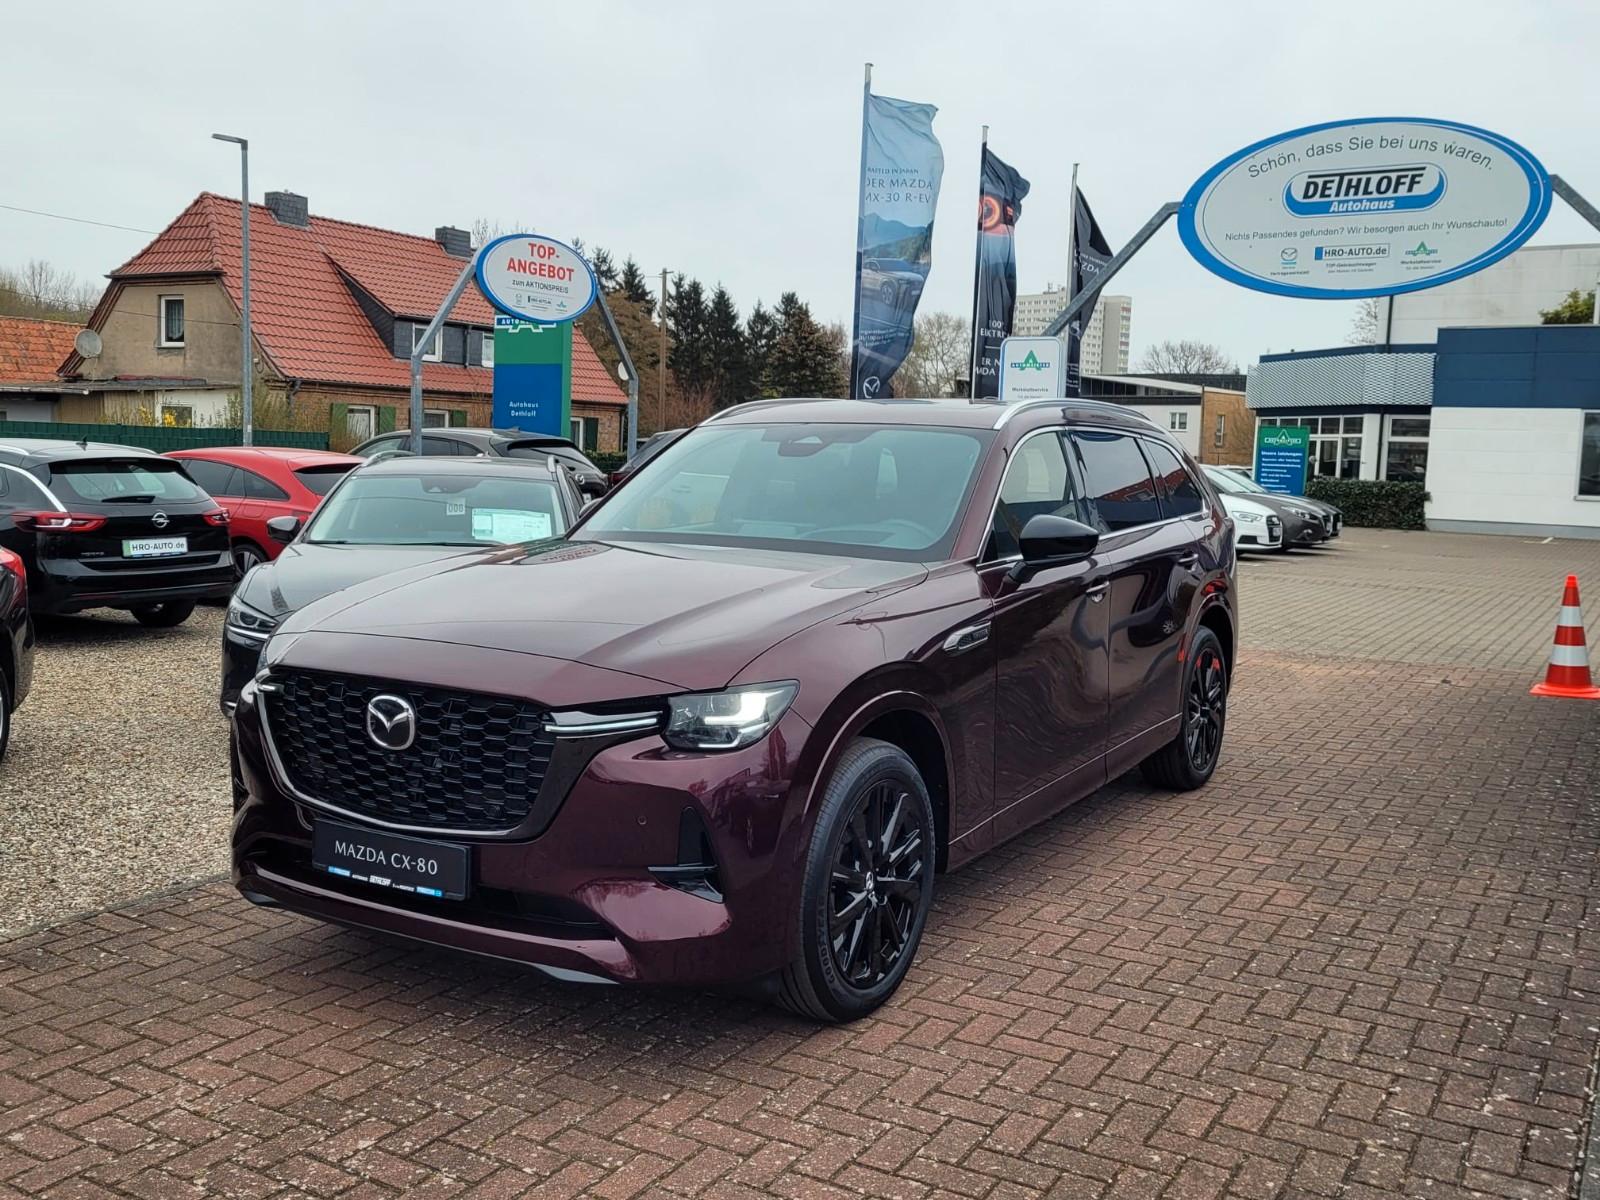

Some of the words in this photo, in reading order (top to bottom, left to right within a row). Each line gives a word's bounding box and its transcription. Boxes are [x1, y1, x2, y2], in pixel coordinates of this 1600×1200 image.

[1248, 152, 1300, 178] Schön,
[1305, 142, 1343, 158] dass
[1348, 136, 1374, 151] Sie
[1379, 135, 1404, 149] bei
[1408, 139, 1438, 152] uns
[1443, 142, 1493, 170] waren.
[889, 178, 933, 190] MAZDA
[1302, 167, 1427, 200] DETHLOFF
[905, 192, 931, 204] R-EV
[1329, 199, 1395, 213] Autohaus
[1225, 232, 1250, 241] Nichts
[1252, 230, 1298, 240] Passendes
[1299, 227, 1345, 239] gefunden?
[1347, 226, 1361, 235] Wir
[1363, 224, 1405, 234] besorgen
[1407, 222, 1430, 232] auch
[1431, 221, 1444, 230] Ihr
[1446, 218, 1508, 230] Wunschauto!
[528, 242, 560, 260] TOP-
[1324, 246, 1387, 257] HRO-AUTO.de
[507, 257, 575, 281] ANGEBOT
[512, 279, 525, 288] zum
[525, 280, 569, 294] AKTIONSPREIS
[334, 839, 387, 865] MAZDA
[391, 853, 438, 876] CX-80
